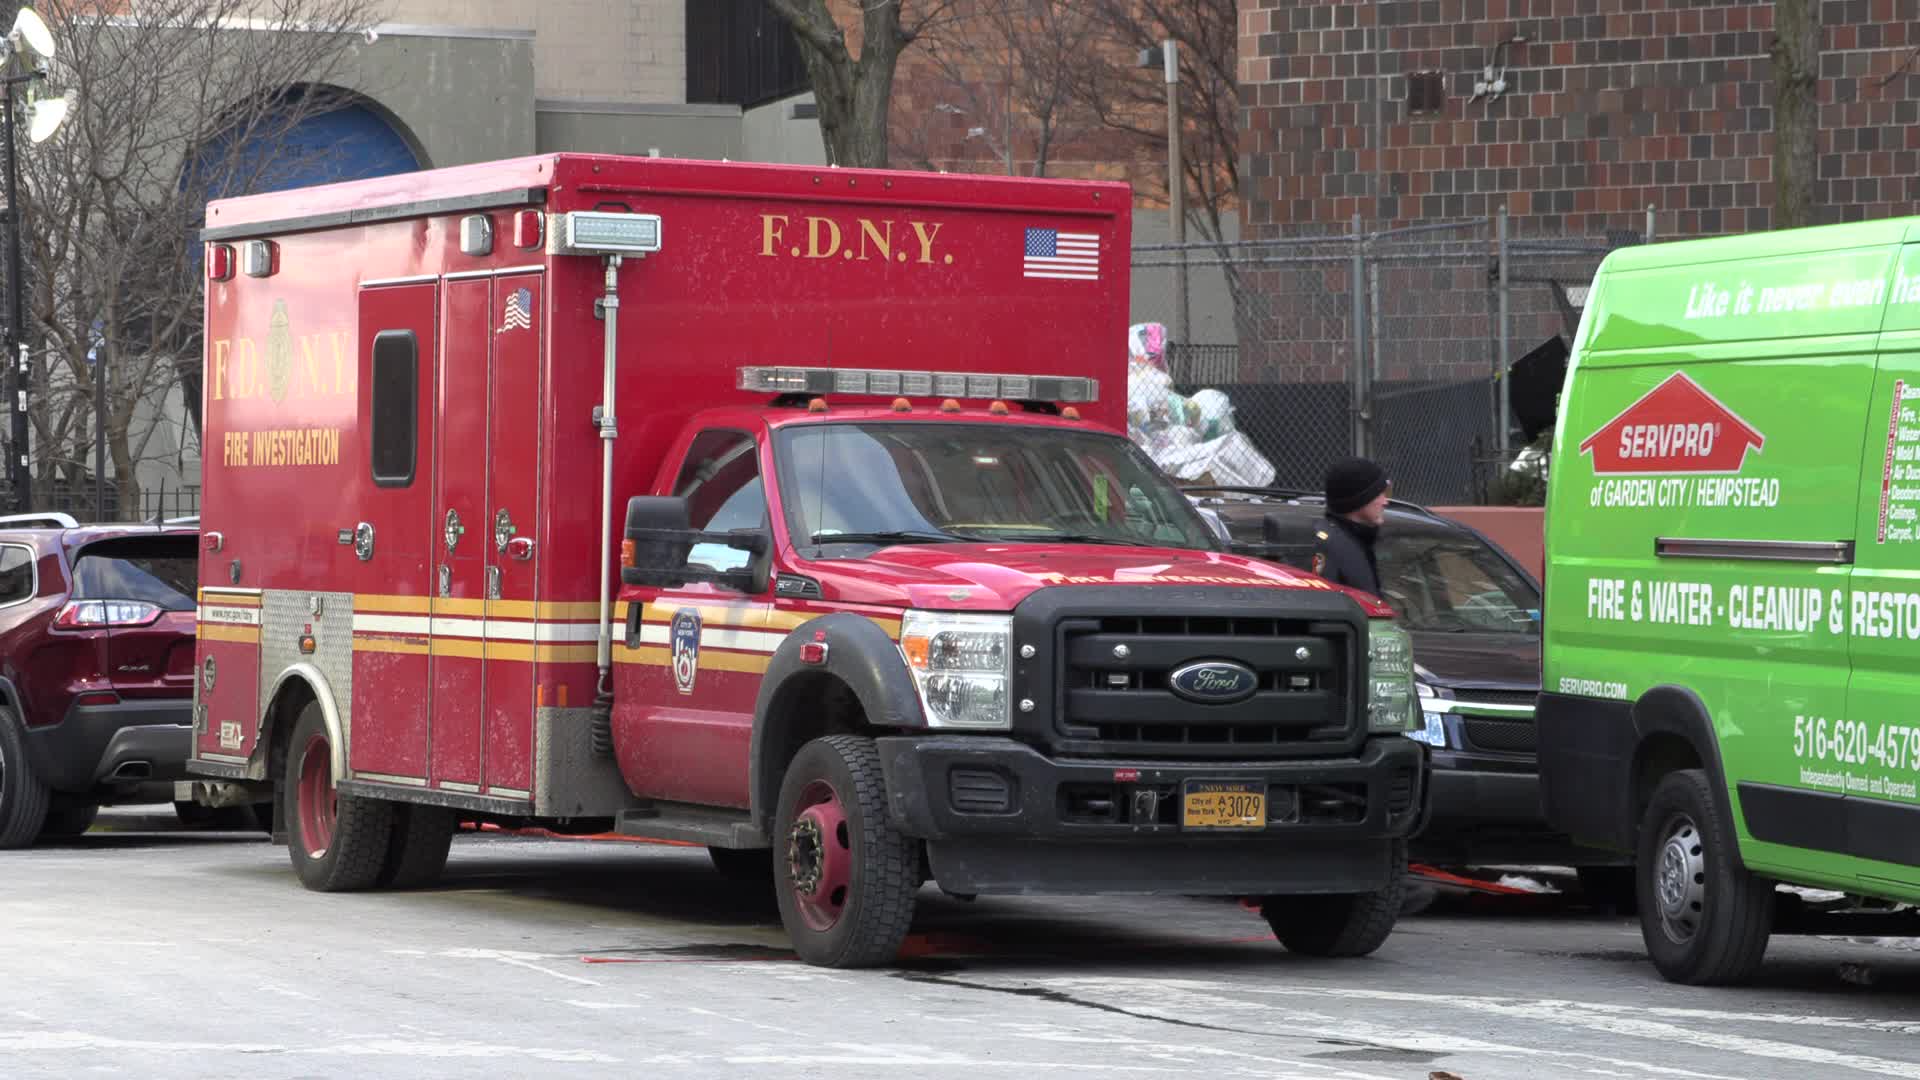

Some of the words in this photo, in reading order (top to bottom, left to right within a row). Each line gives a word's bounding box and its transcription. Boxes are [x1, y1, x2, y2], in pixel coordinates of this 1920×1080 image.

[758, 214, 953, 264] F.D.N.Y.
[1684, 281, 1730, 319] Like
[1733, 280, 1754, 316] it
[1757, 284, 1825, 313] never
[224, 431, 249, 467] FIRE
[252, 427, 339, 466] INVESTIGATION
[1590, 480, 1603, 507] of
[1604, 479, 1656, 507] GARDEN
[1658, 479, 1688, 507] CITY
[1696, 478, 1780, 507] HEMPSTEAD
[1588, 578, 1625, 620] FIRE
[1630, 580, 1643, 622] &
[1648, 581, 1713, 626] WATER
[1729, 584, 1823, 632] CLEANUP
[1829, 589, 1844, 634] &
[1851, 590, 1920, 640] RESTO
[1193, 668, 1239, 690] Ford
[1559, 677, 1628, 700] SERVPRO.COM
[1794, 715, 1920, 772] 516-620-4579
[1800, 765, 1846, 793] Independently
[1846, 771, 1869, 792] Owned
[1870, 776, 1883, 794] and
[1884, 776, 1917, 800] Operated
[1227, 795, 1261, 817] 3029
